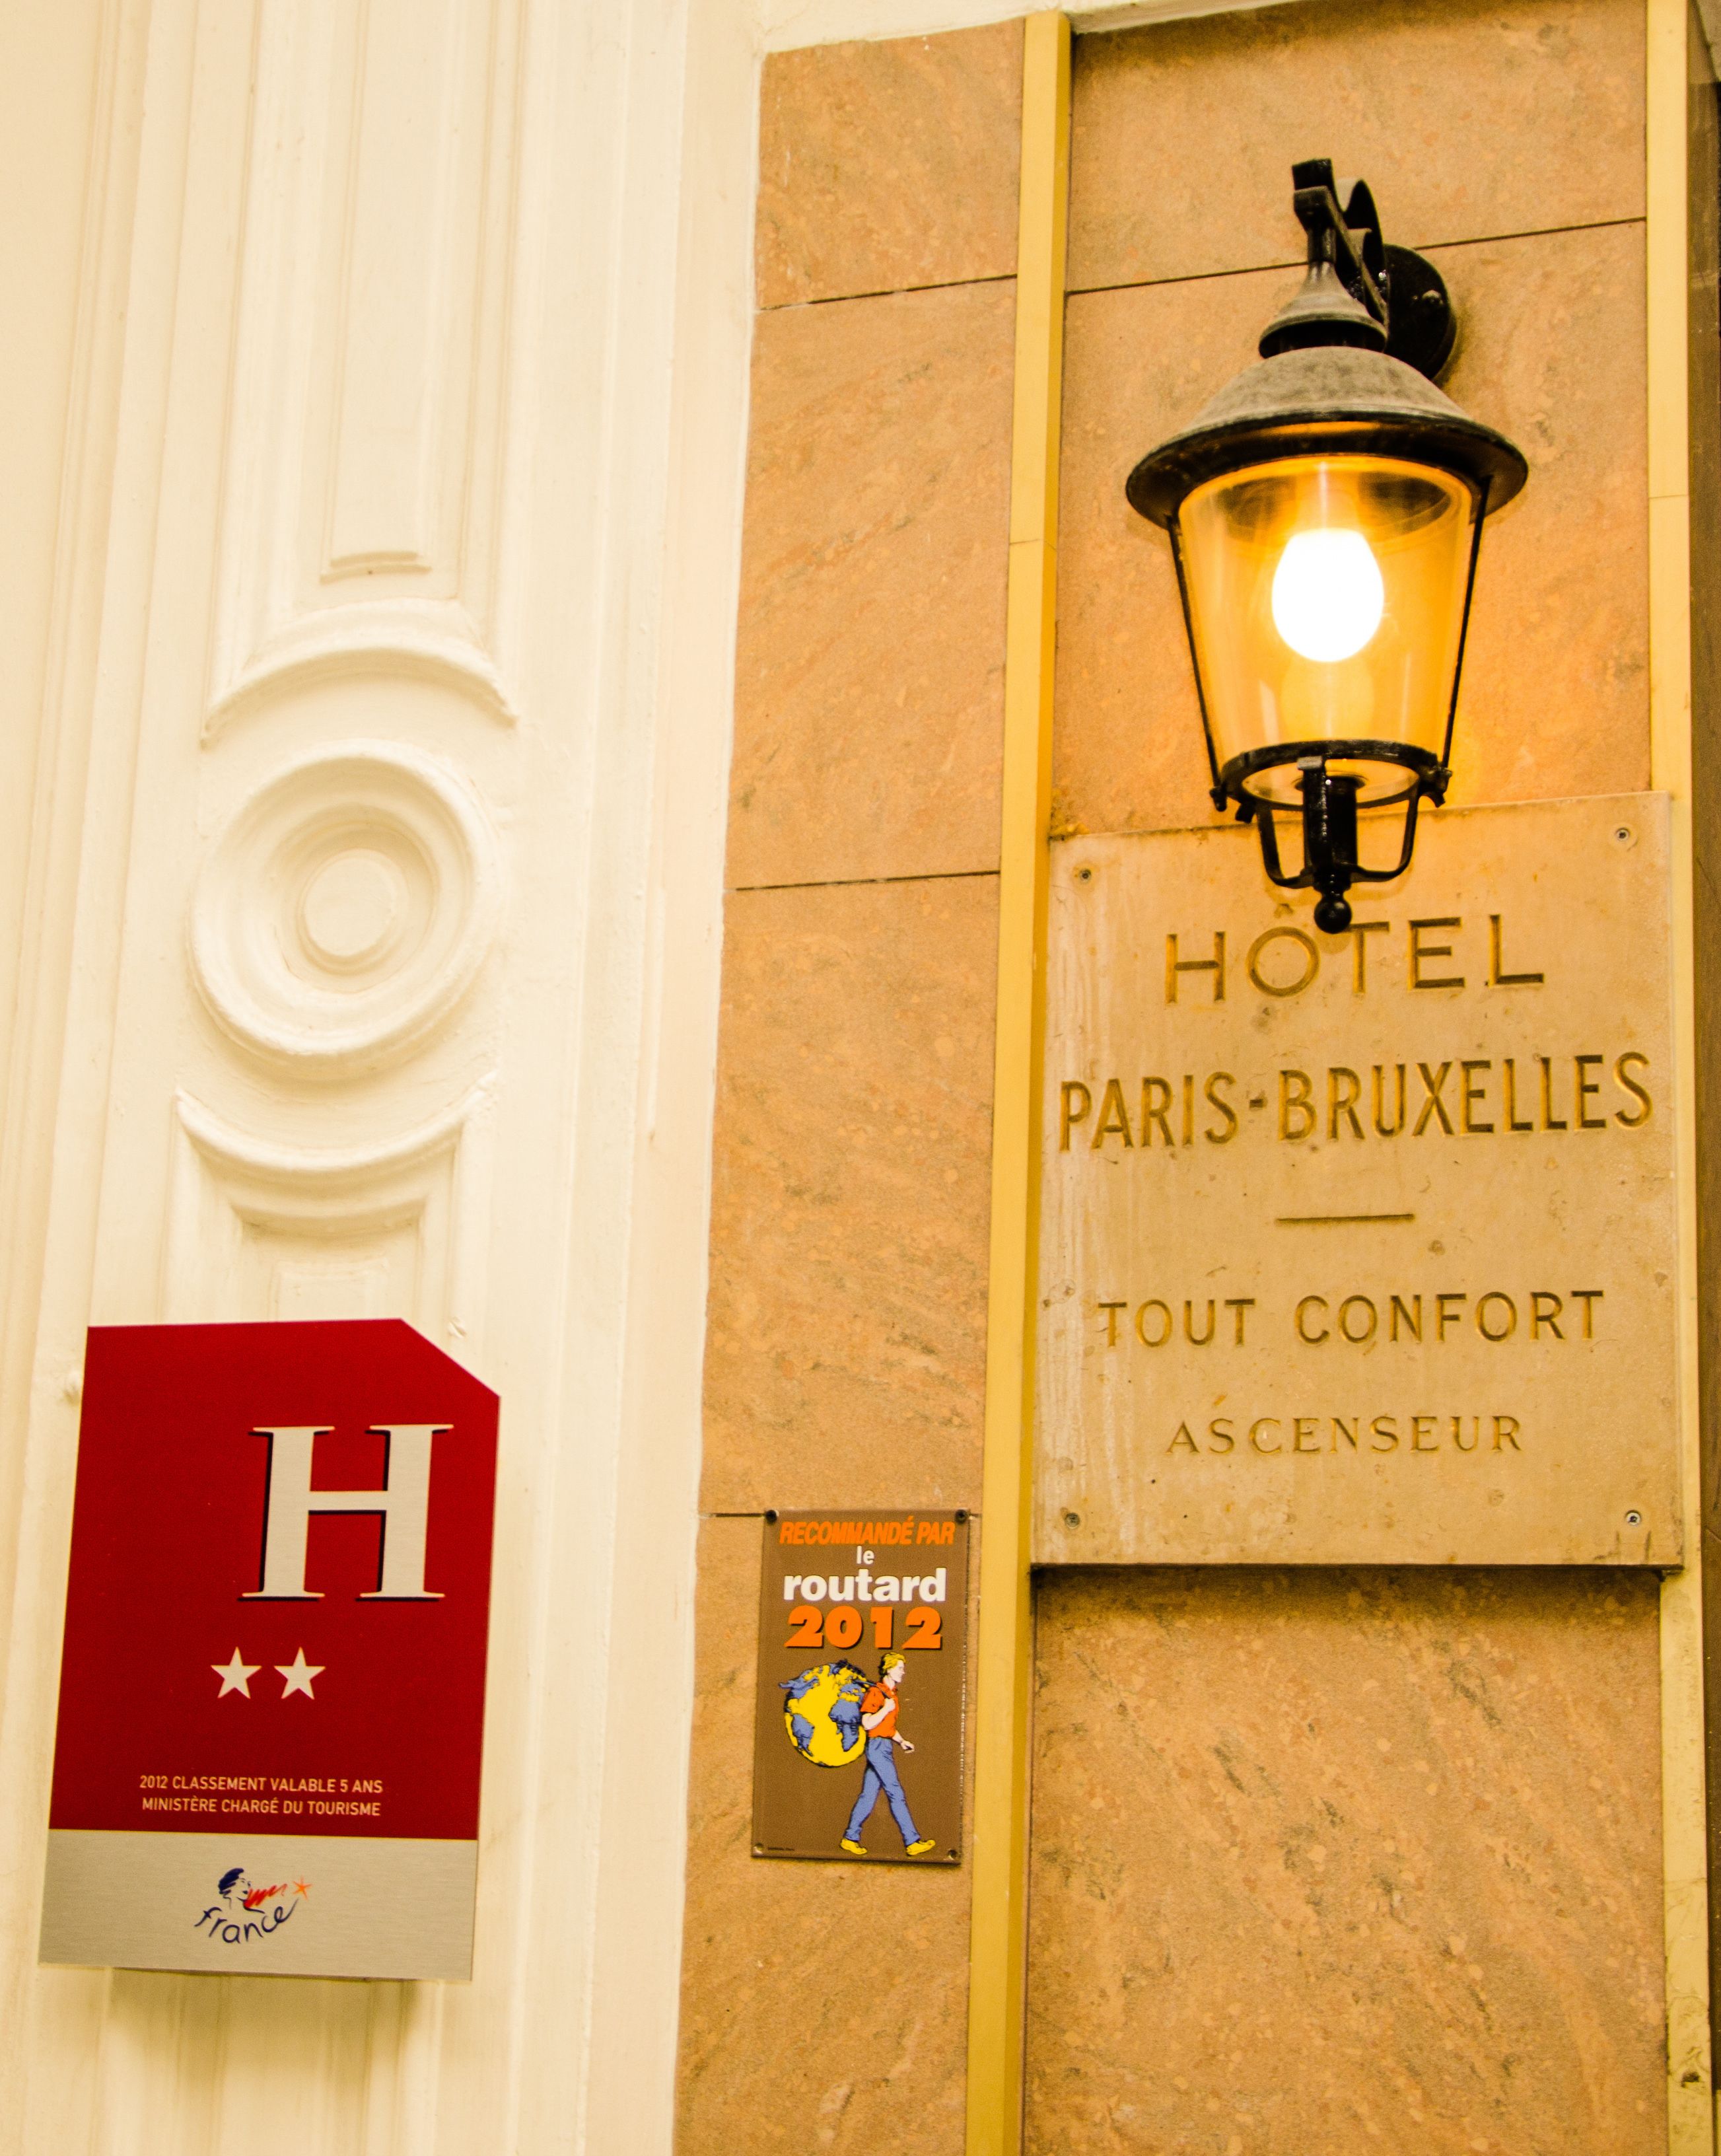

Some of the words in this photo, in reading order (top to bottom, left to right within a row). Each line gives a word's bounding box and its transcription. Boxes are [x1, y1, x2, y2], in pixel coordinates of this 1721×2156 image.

[1059, 1051, 1654, 1152] PARIS-BRUXELLES
[1098, 1298, 1255, 1348] TOUT
[1294, 1290, 1604, 1344] CONFORT
[1166, 1415, 1523, 1454] ASCENSEUR
[240, 1424, 454, 1601] H
[779, 1515, 914, 1546] RECOMMANDÉ
[915, 1521, 956, 1546] PAR
[856, 1545, 875, 1565] le
[783, 1567, 947, 1602] routard
[783, 1605, 943, 1649] 2012
[139, 1775, 168, 1789] 2012
[172, 1776, 266, 1791] CLASSEMENT
[269, 1778, 336, 1793] VALABLE
[339, 1779, 348, 1793] 5
[351, 1779, 384, 1794] ANS
[142, 1795, 217, 1813] MINISTÈRE
[221, 1797, 279, 1814] CHARGÉ
[283, 1801, 304, 1815] DU
[308, 1801, 381, 1816] TOURISME
[194, 1898, 299, 1944] france
